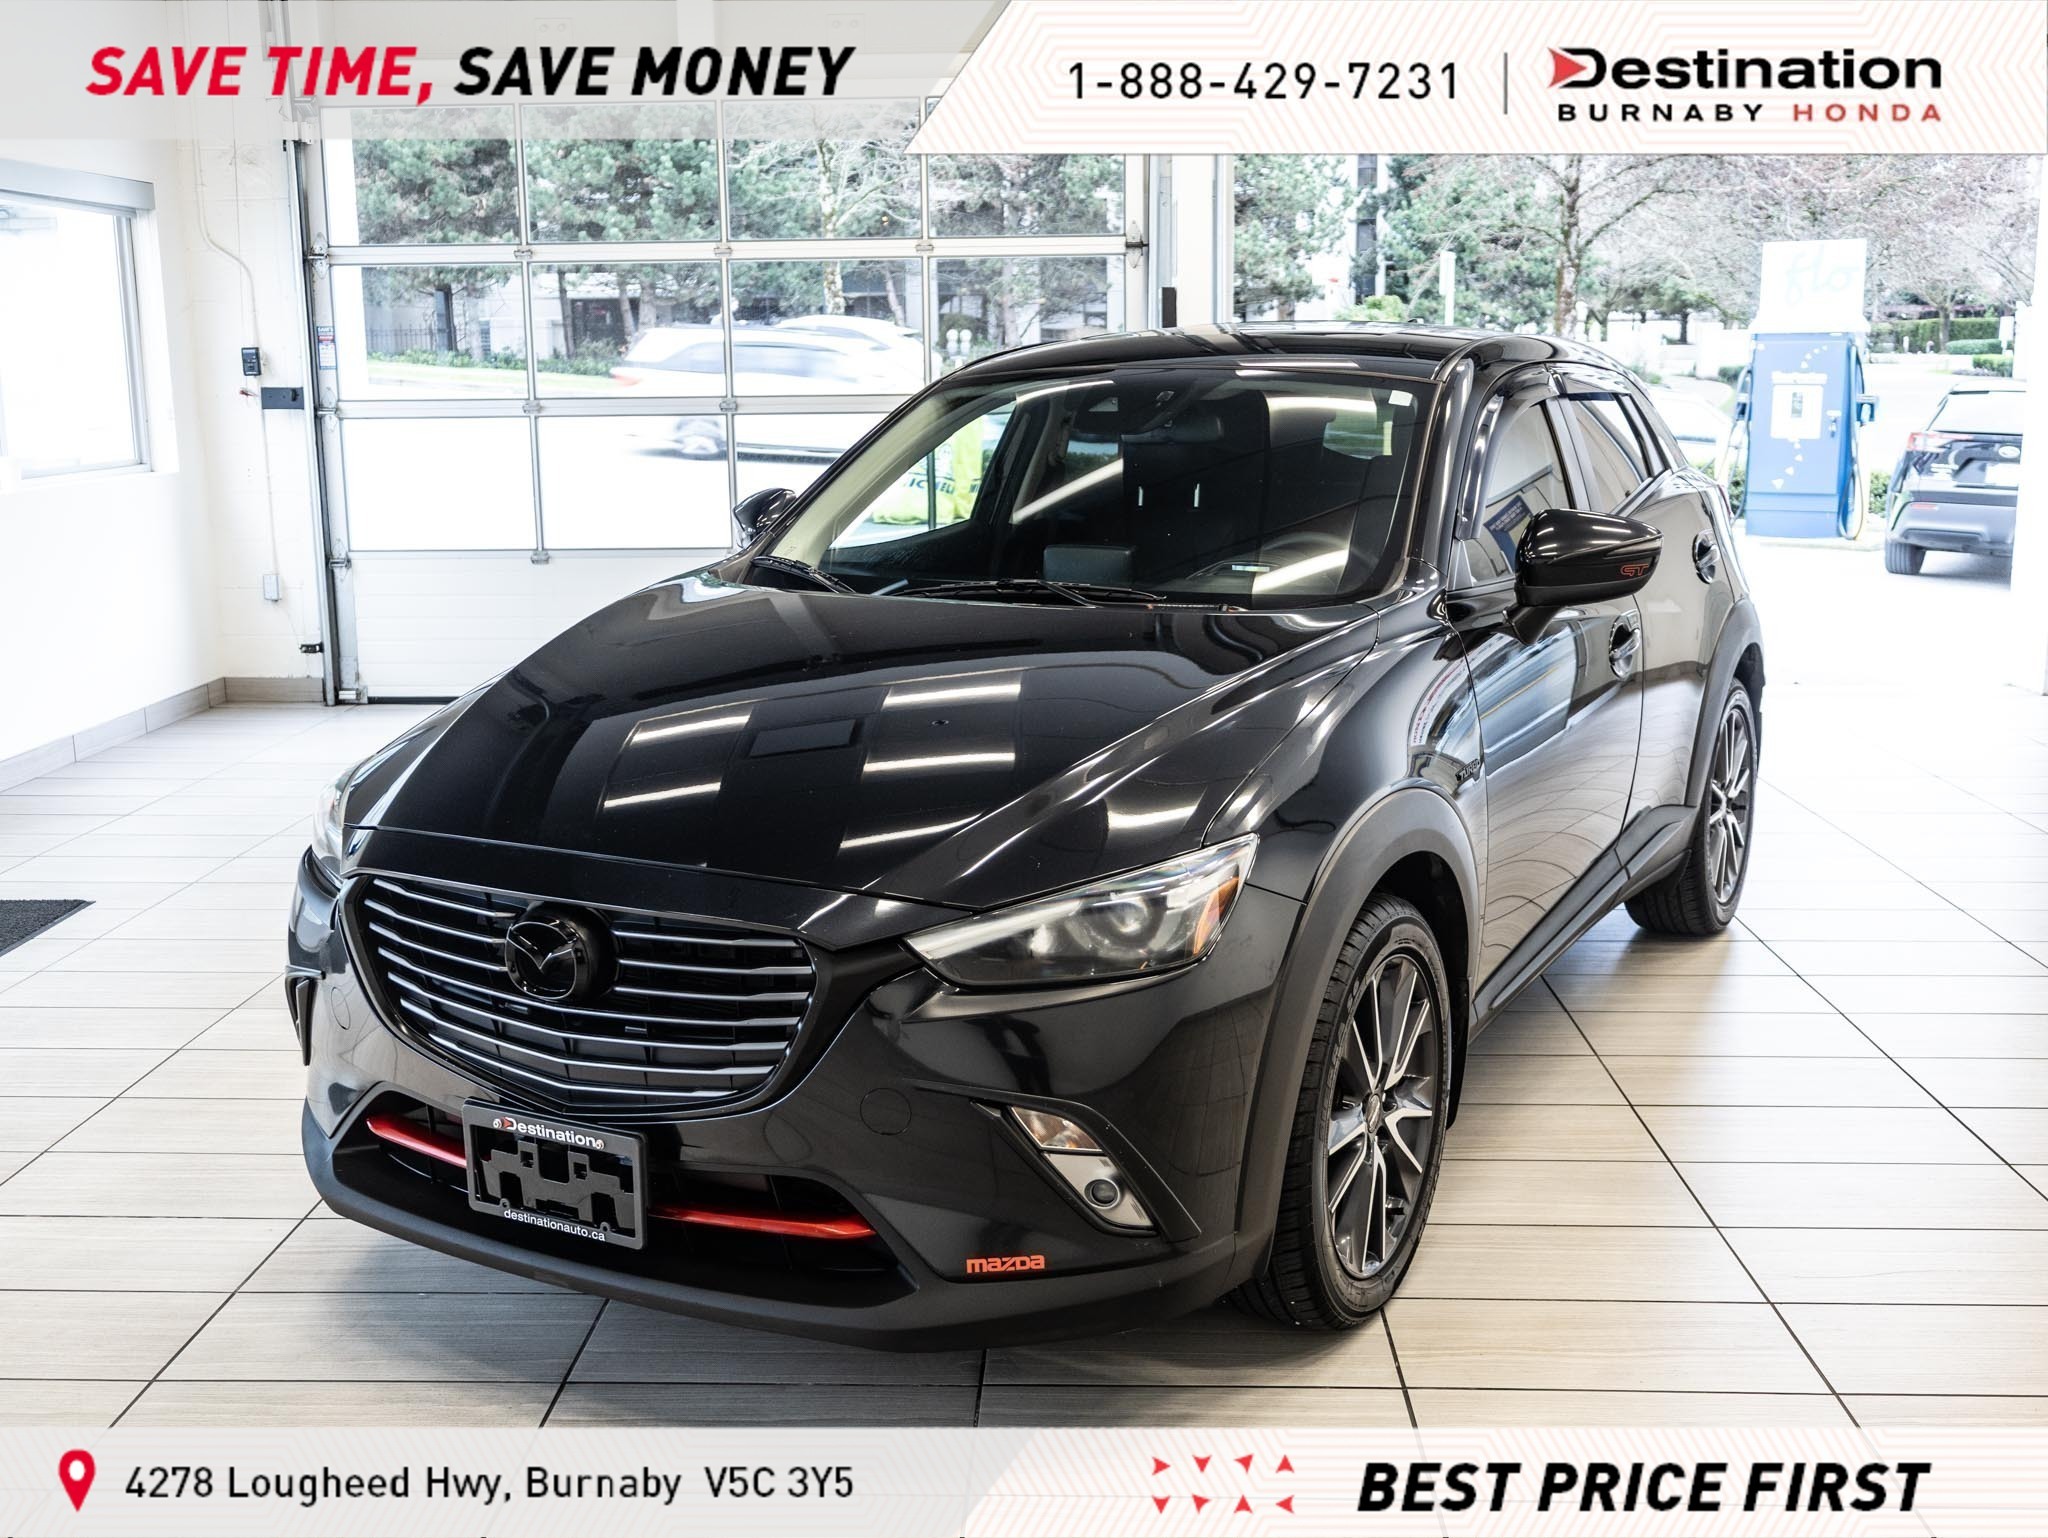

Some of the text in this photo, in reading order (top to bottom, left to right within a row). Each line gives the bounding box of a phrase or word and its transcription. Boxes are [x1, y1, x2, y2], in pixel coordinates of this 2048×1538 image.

[1620, 563, 1649, 577] GT
[502, 1116, 597, 1148] Destination
[503, 1209, 606, 1242] destinationauto.ca
